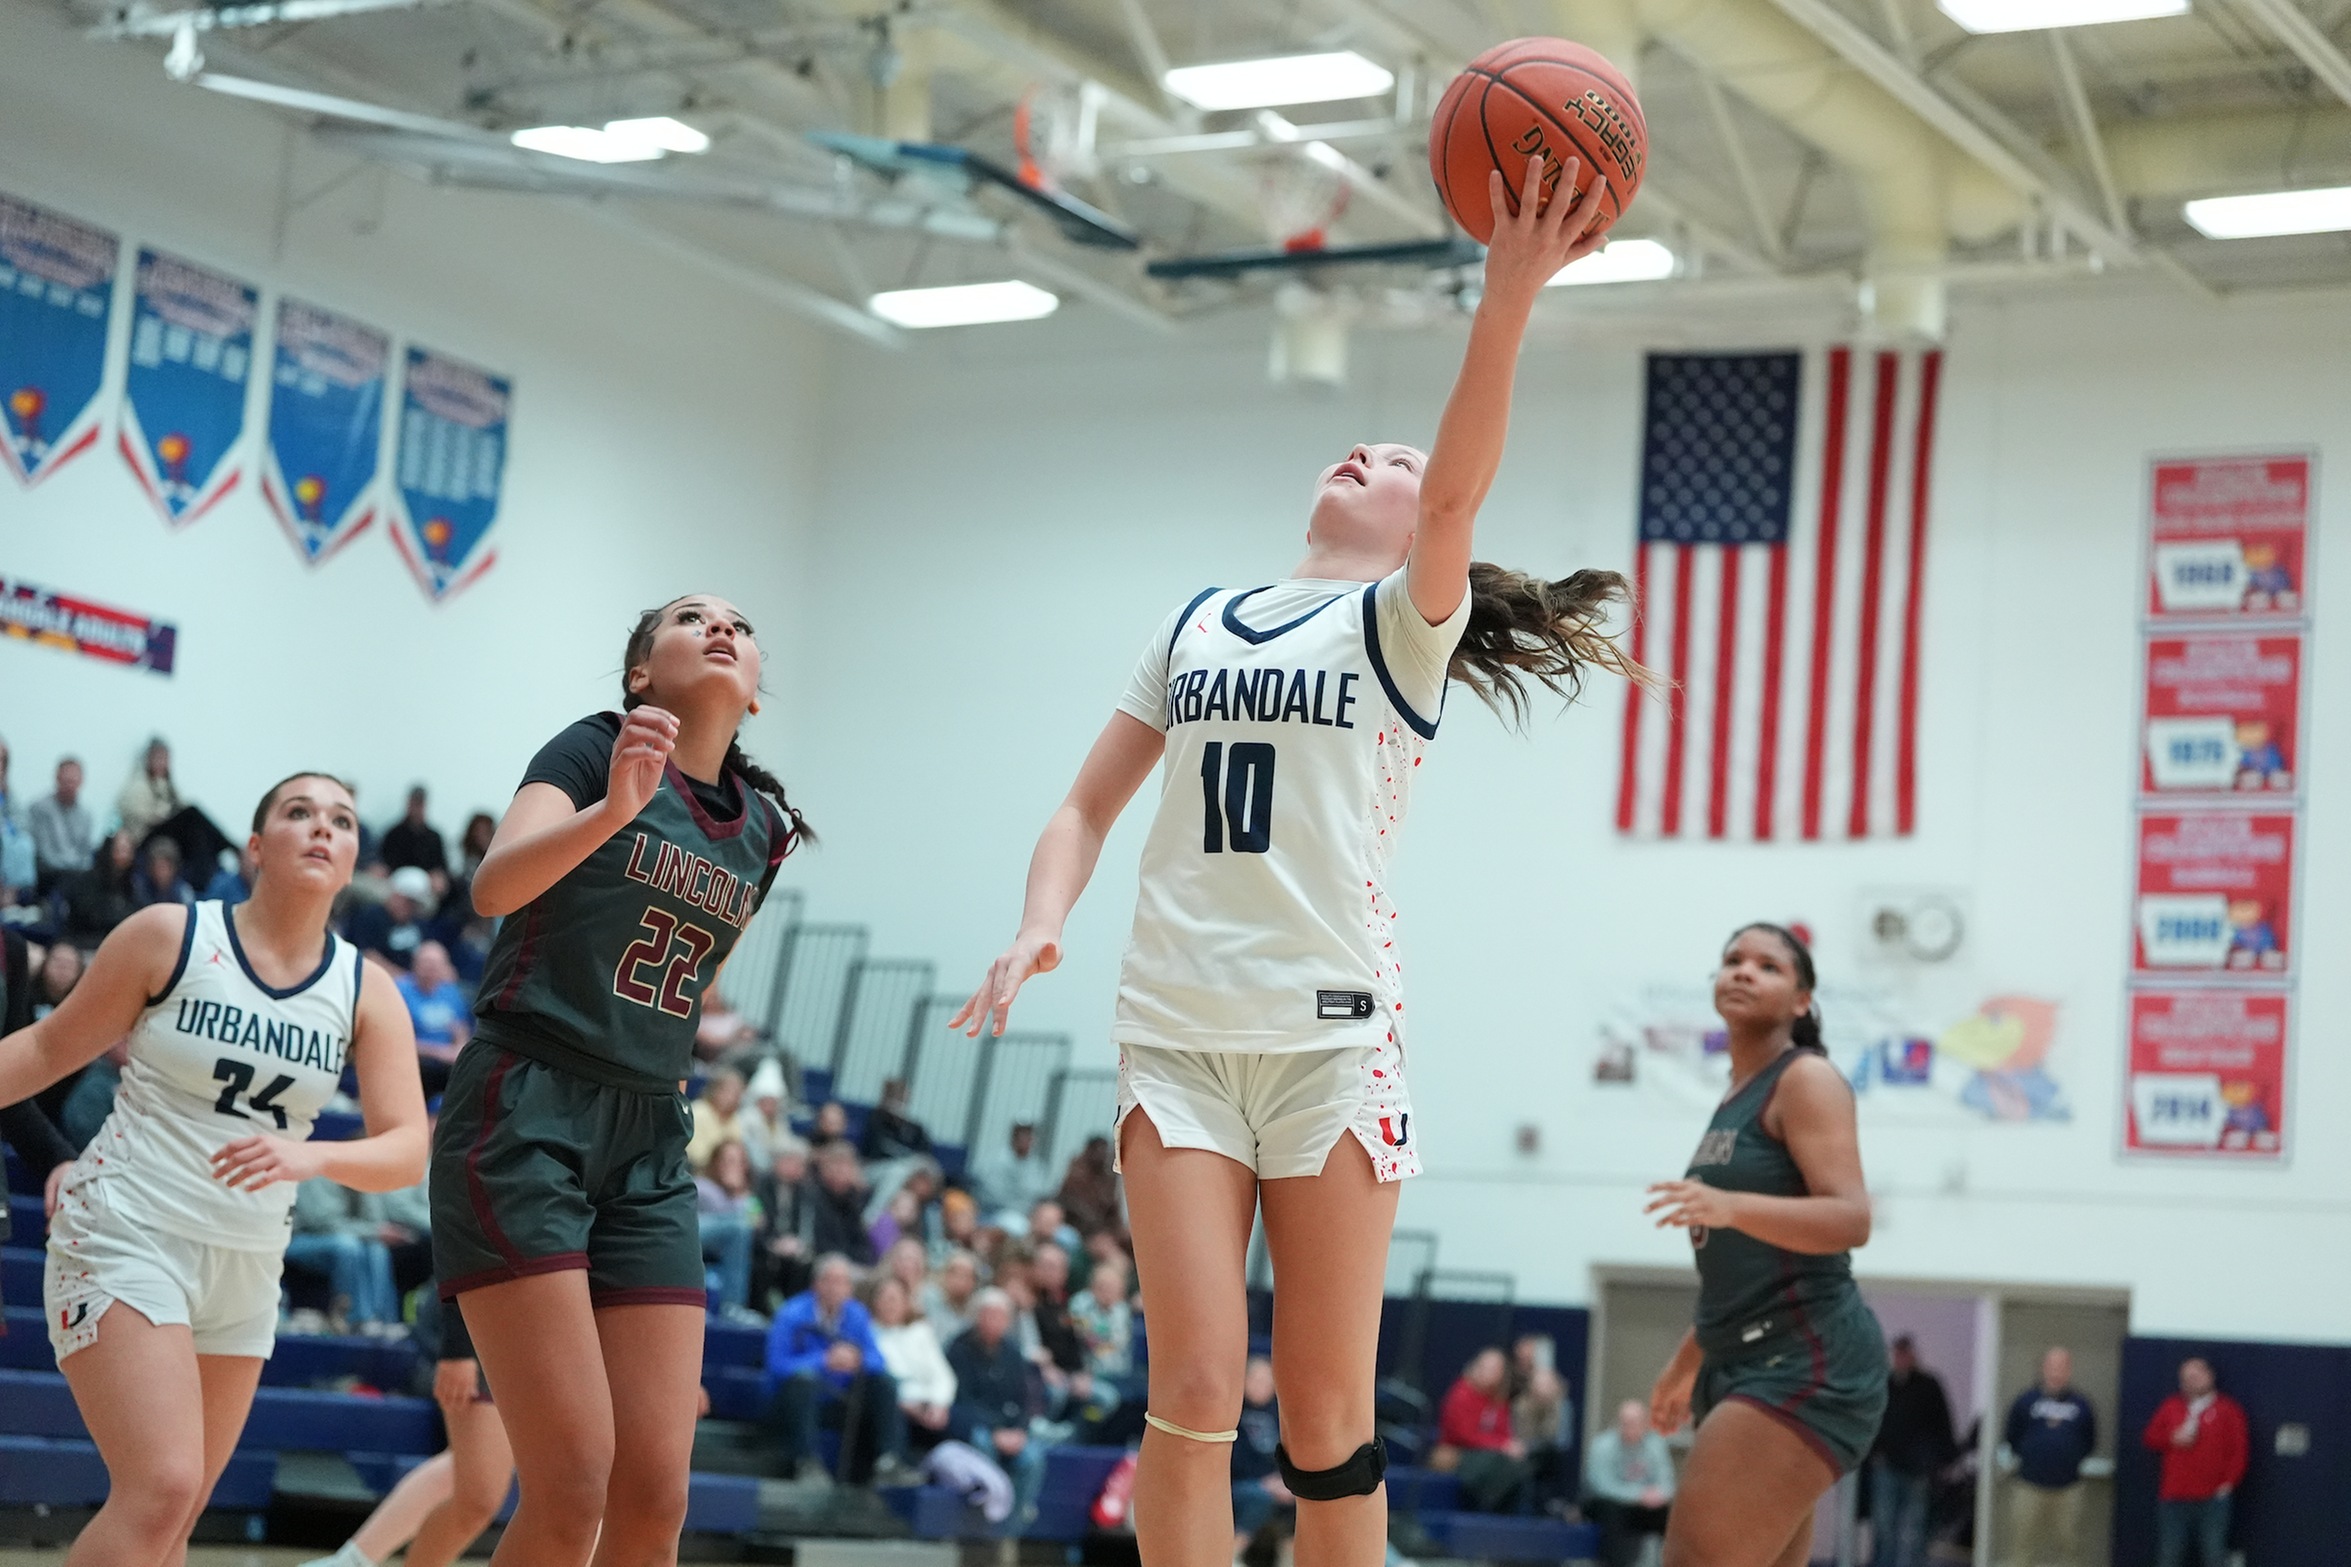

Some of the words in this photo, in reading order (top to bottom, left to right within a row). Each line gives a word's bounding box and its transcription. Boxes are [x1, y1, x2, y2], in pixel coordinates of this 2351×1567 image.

[1562, 97, 1638, 196] LEGACY
[1200, 741, 1276, 853] 10
[624, 832, 757, 931] LINCOLN
[612, 905, 715, 1020] 22
[1360, 1000, 1367, 1012] S
[176, 998, 346, 1075] URBANDALE
[212, 1057, 297, 1130] 24
